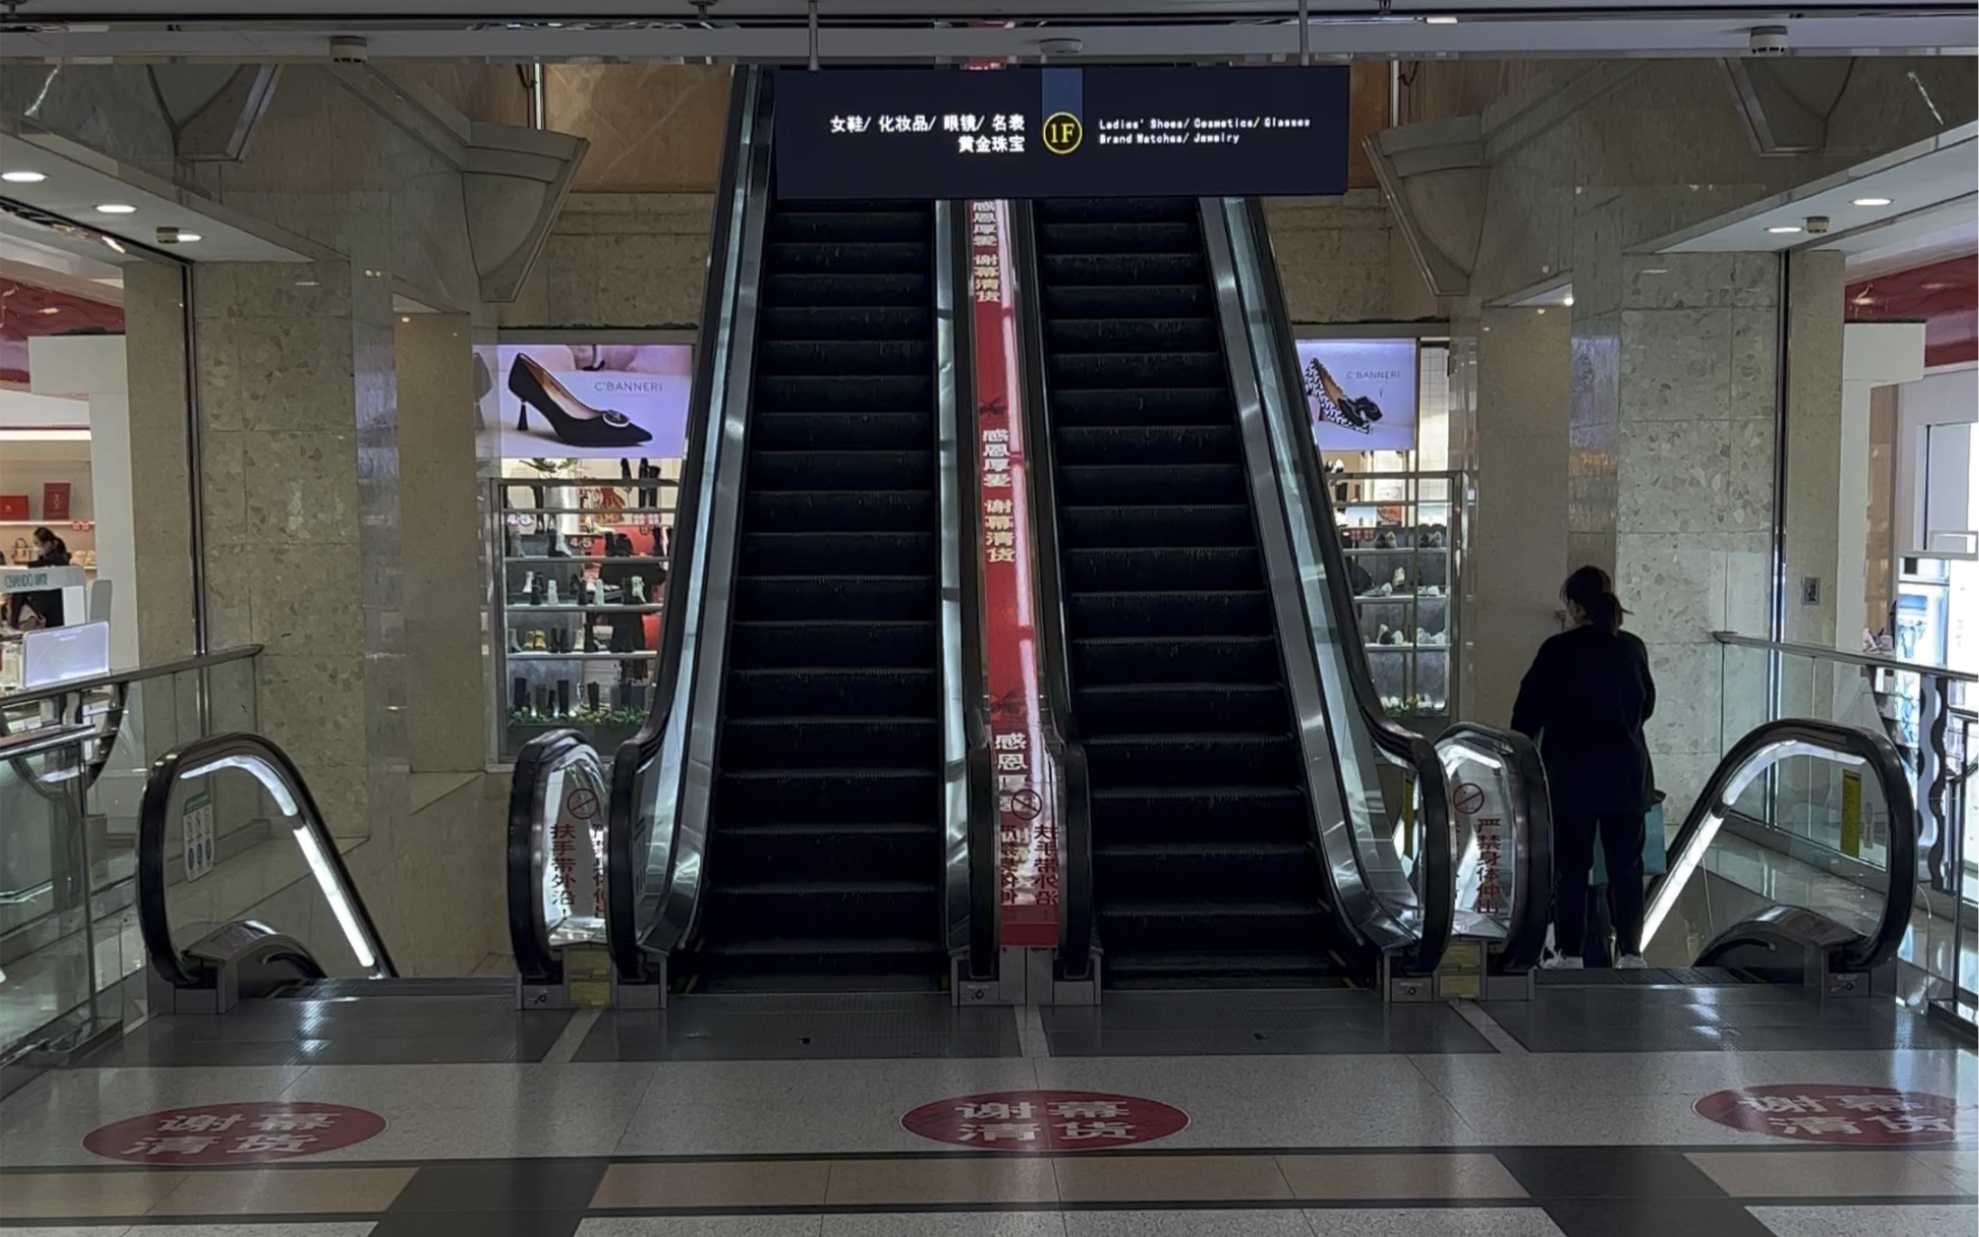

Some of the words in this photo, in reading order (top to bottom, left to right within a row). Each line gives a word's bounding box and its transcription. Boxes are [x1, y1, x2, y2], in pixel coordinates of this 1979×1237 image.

[830, 115, 871, 132] 女鞋/
[879, 115, 936, 132] 化妆品/
[944, 115, 984, 132] 眼镜/
[992, 114, 1025, 132] 名表
[1099, 119, 1144, 130] Ladies'
[1150, 118, 1190, 130] Shoes/
[1264, 117, 1310, 128] Glasses
[1050, 123, 1075, 144] 1F
[1099, 134, 1132, 144] Brand
[958, 135, 1025, 152] 黄金珠宝
[1476, 818, 1501, 913] 严禁身体伸出
[955, 1101, 1132, 1119] 谢幕
[1738, 1096, 1923, 1113] 谢幕
[157, 1113, 342, 1131] 谢幕
[958, 1121, 1138, 1140] 清货
[120, 1134, 318, 1154] 清货
